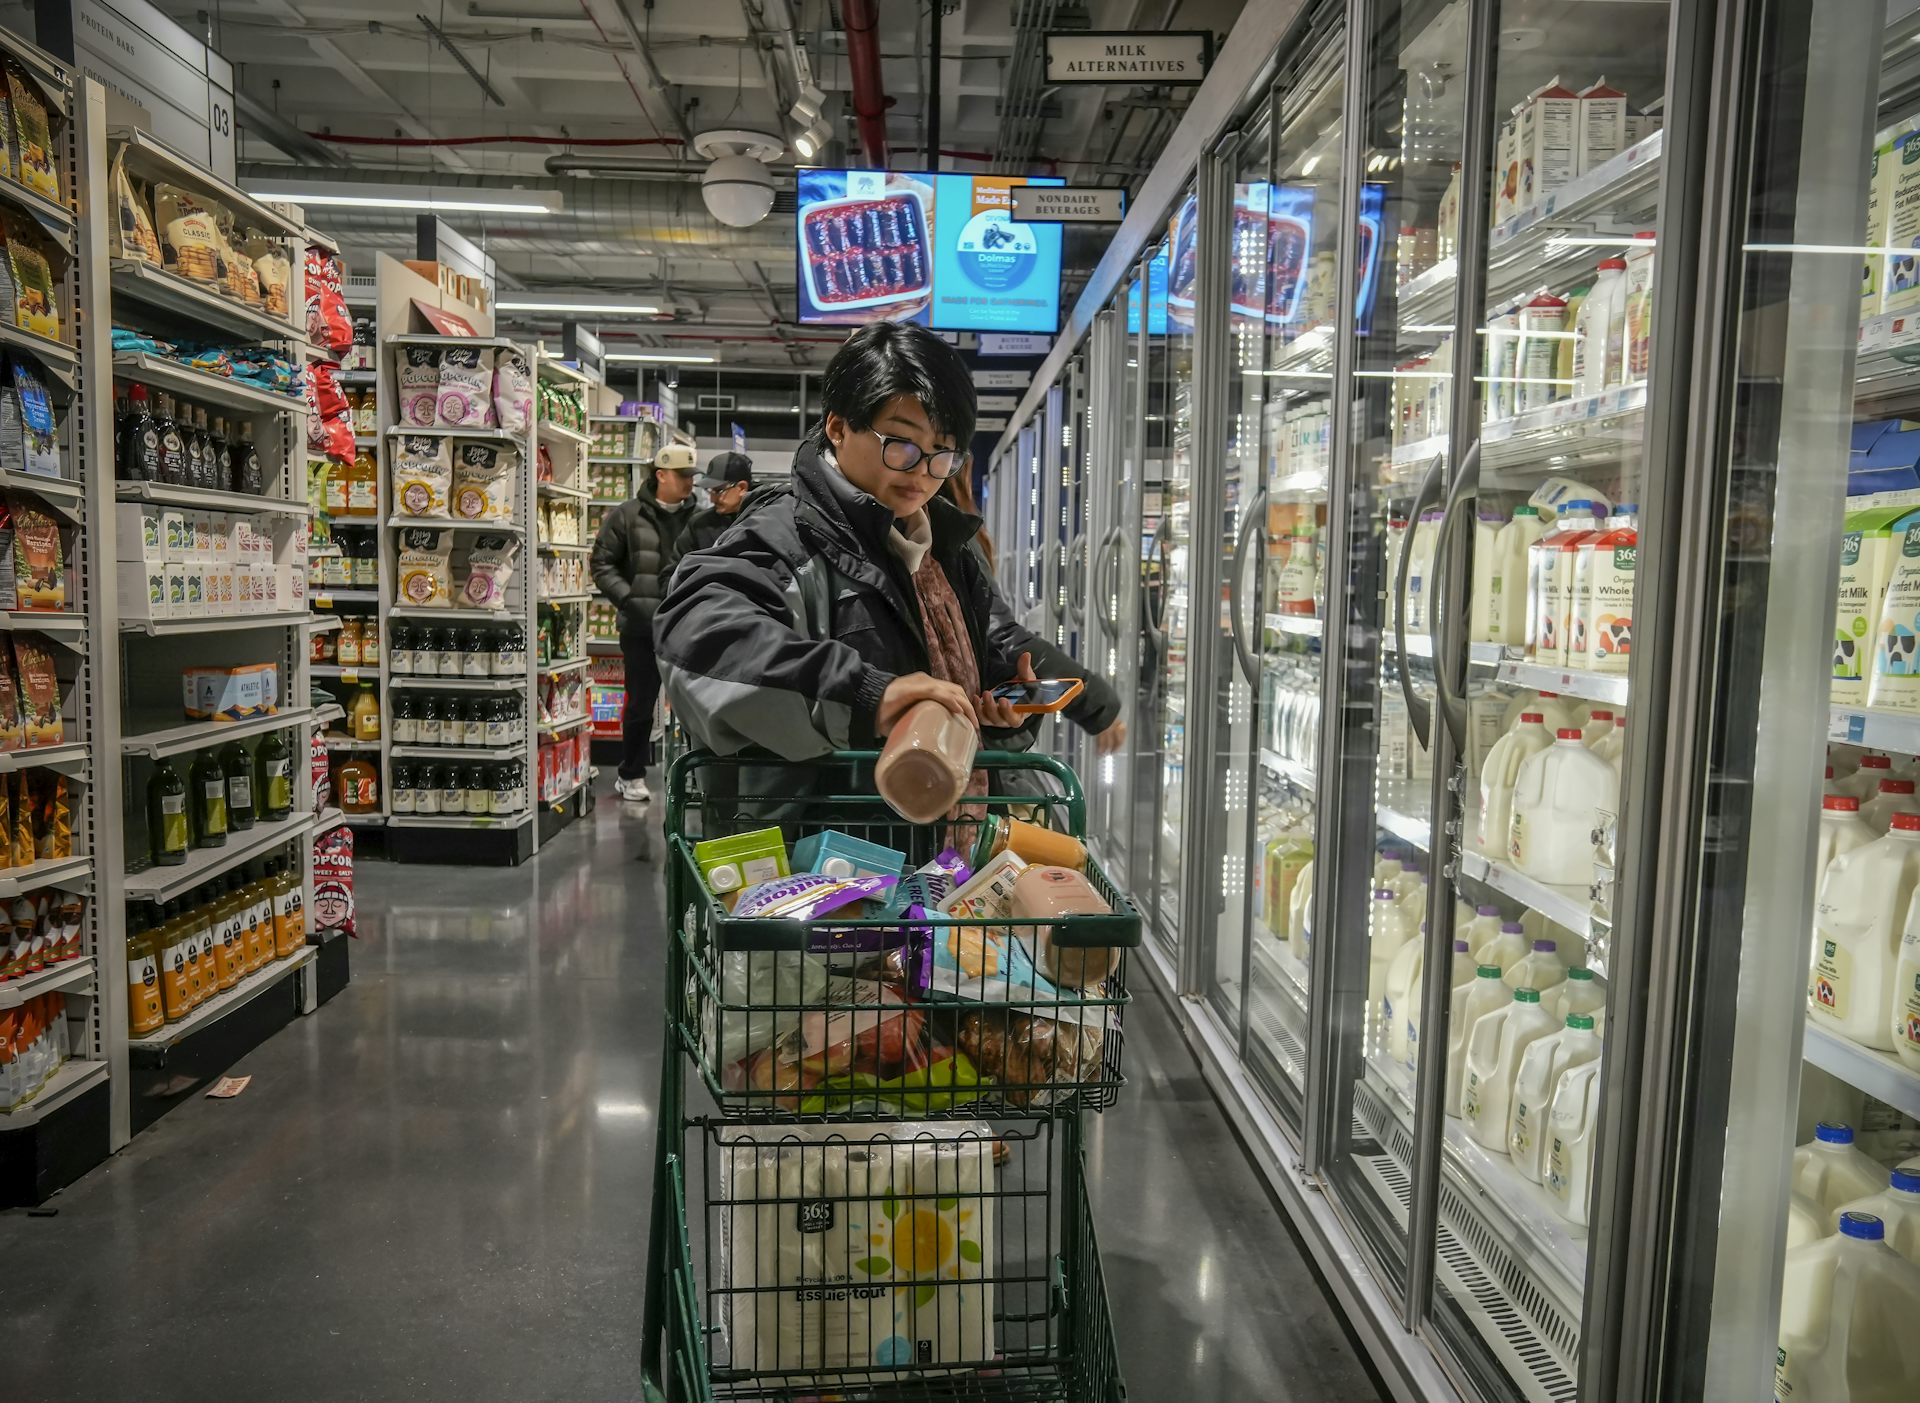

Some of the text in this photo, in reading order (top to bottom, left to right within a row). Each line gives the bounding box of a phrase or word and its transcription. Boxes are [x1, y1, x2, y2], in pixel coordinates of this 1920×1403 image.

[80, 11, 135, 57] PROTEIN BARS
[1105, 45, 1146, 57] MILK
[1066, 60, 1185, 72] ALTERNATIVES
[83, 65, 143, 108] COCONUT WATER
[213, 103, 229, 137] 03
[1038, 194, 1098, 204] NONDAIRY
[1035, 205, 1101, 215] BEVERAGES
[183, 228, 211, 239] CLASSIC
[978, 253, 1016, 263] Dolmas
[1616, 549, 1637, 561] 365
[1599, 586, 1631, 595] Whole
[1849, 587, 1868, 599] Milk
[803, 1202, 830, 1221] 365
